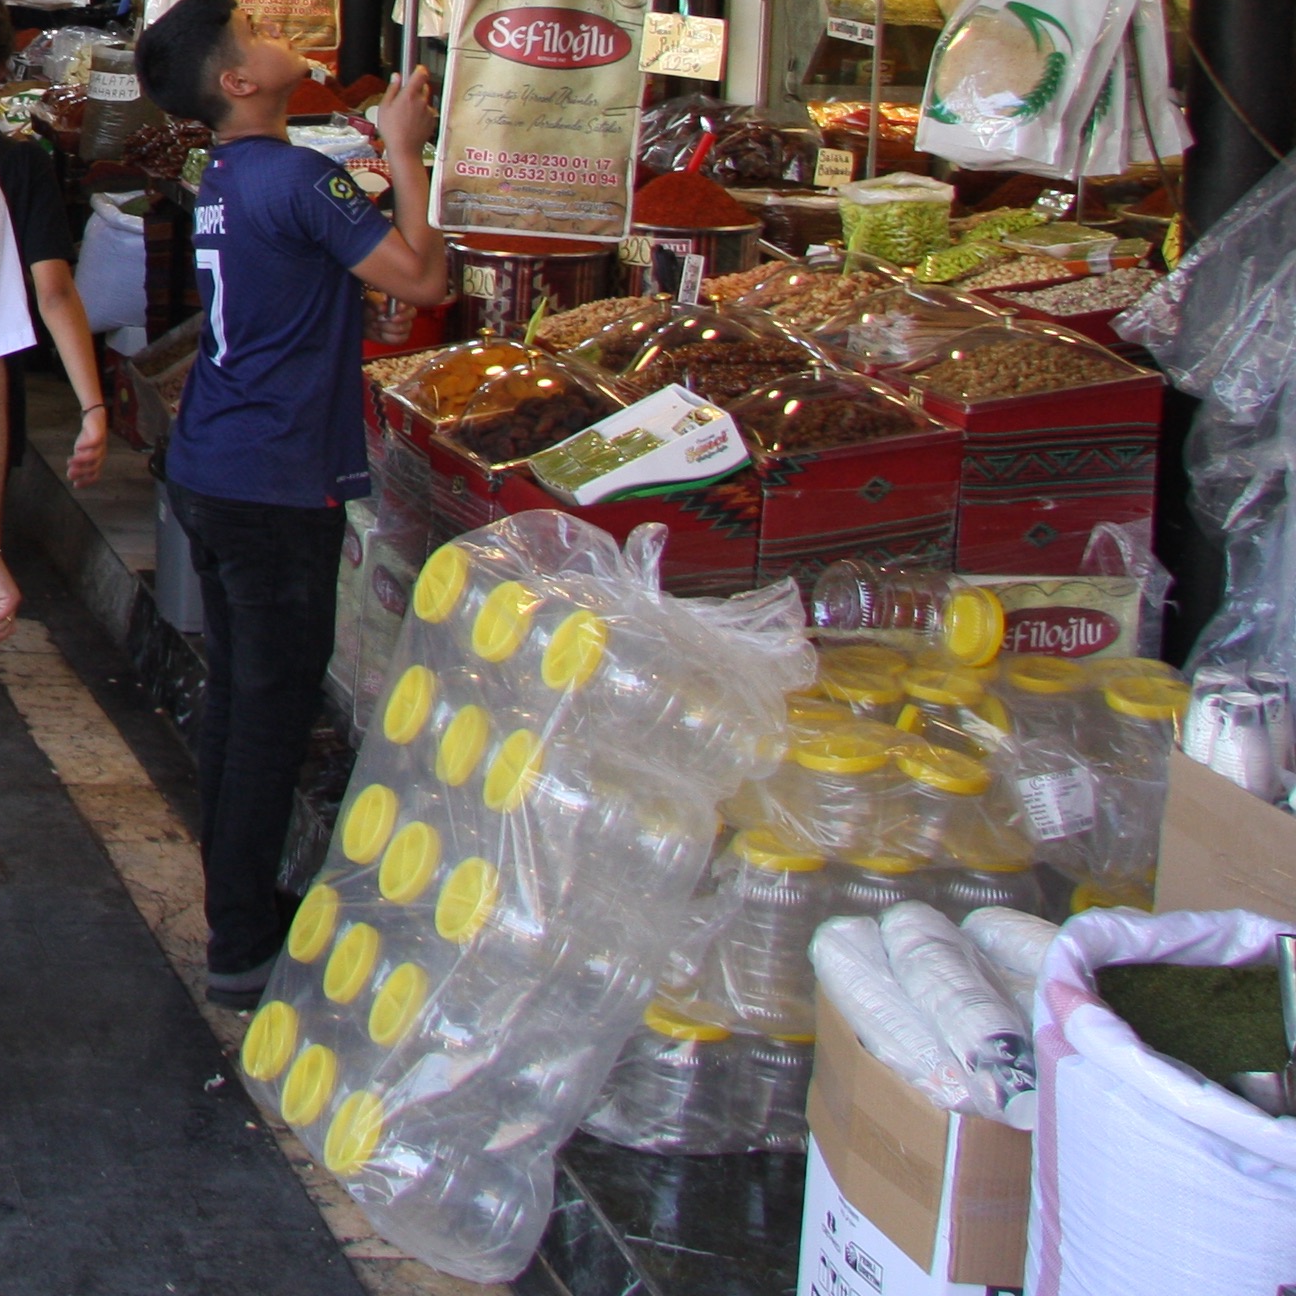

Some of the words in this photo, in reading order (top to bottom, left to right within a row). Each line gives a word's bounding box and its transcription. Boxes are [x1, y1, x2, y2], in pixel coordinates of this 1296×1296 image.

[486, 13, 615, 64] Sefiloğlu
[92, 74, 136, 87] ALATA
[455, 161, 491, 177] Gsm
[503, 166, 546, 182] 0.532
[548, 170, 577, 183] 310
[580, 171, 597, 184] 10
[600, 173, 618, 186] 94
[464, 147, 494, 162] Tel:
[497, 151, 538, 166] 0.342
[541, 155, 569, 168] 230
[572, 157, 589, 169] 01
[595, 157, 613, 171] 17
[620, 236, 653, 265] 320
[463, 265, 495, 297] 320
[195, 248, 228, 368] 7
[1002, 616, 1103, 654] efiloğlu
